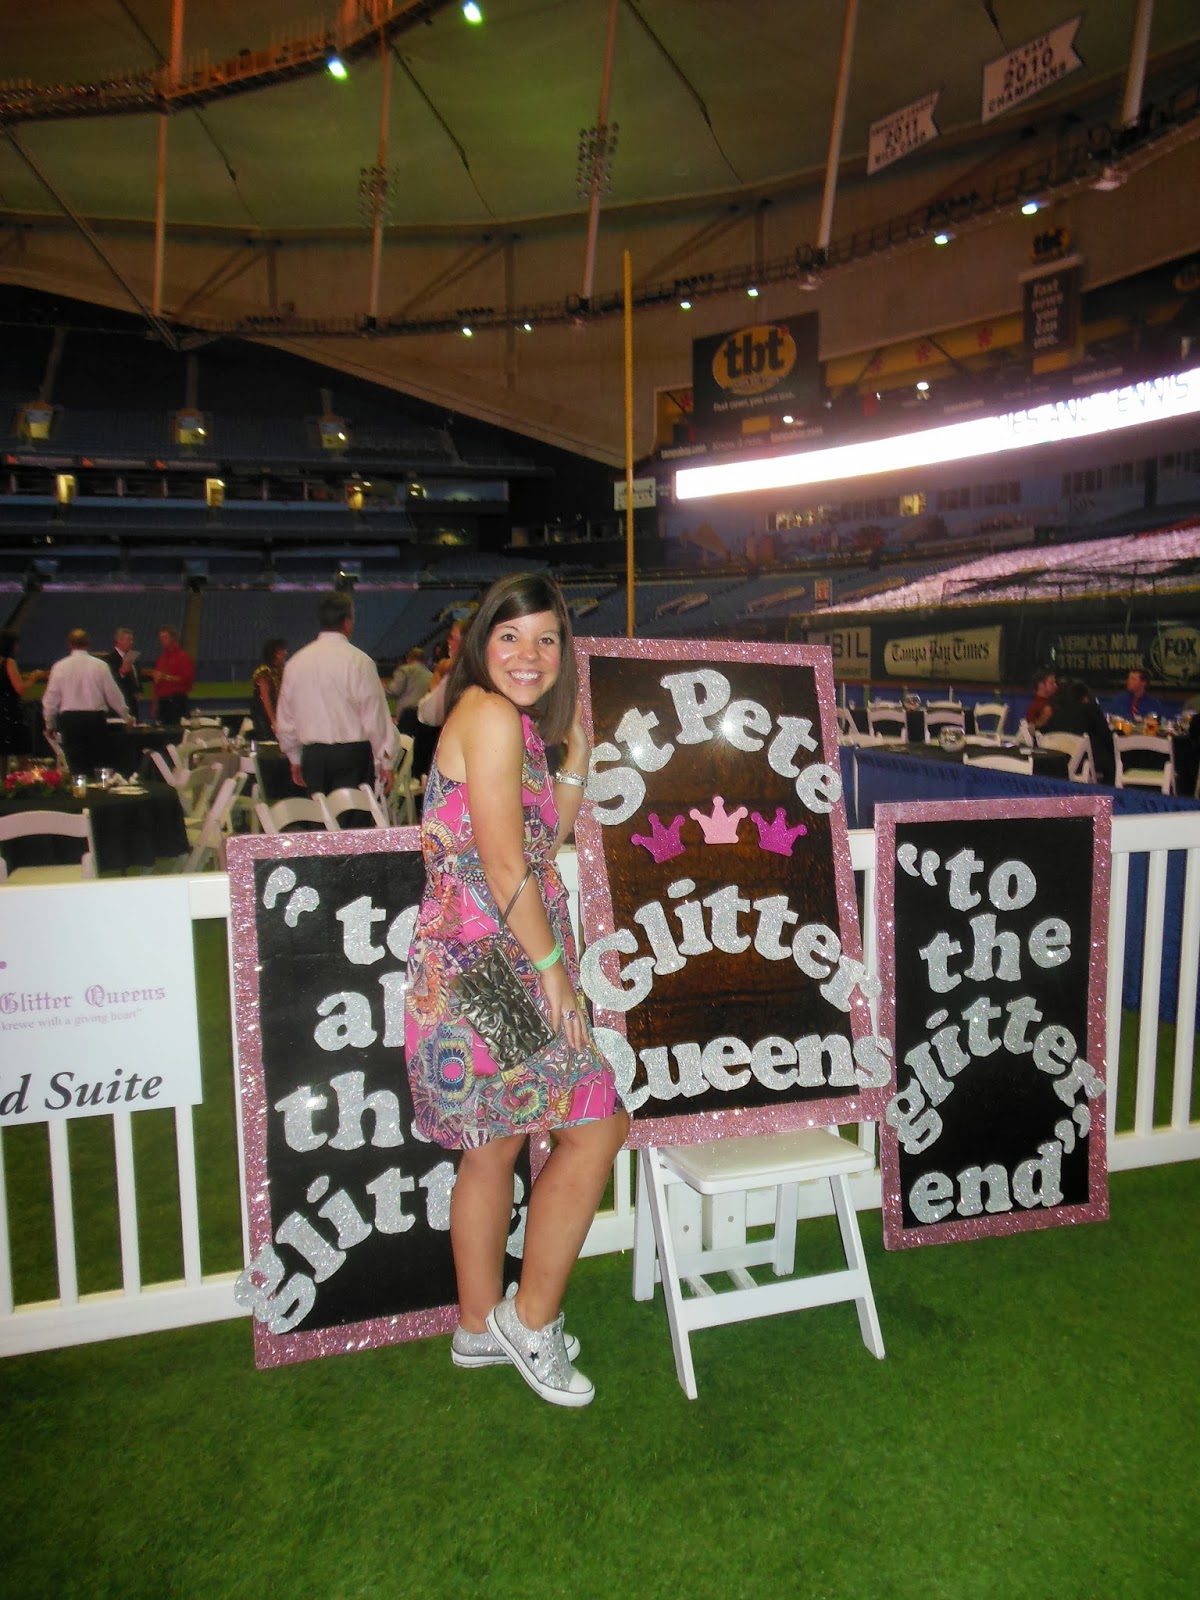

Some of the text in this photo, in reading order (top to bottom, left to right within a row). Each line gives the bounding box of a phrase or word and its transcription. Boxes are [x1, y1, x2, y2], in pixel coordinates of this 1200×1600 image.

[1003, 47, 1054, 92] 2010
[723, 329, 786, 379] tbt
[891, 636, 990, 667] Tampa Bay Times
[1165, 637, 1197, 658] FOX
[582, 668, 842, 826] St Pete
[579, 878, 882, 1012] Glitter
[919, 913, 1071, 993] the
[0, 984, 166, 1014] Glitter Queens
[1, 1020, 34, 1031] krewe
[38, 1016, 62, 1027] with
[64, 1018, 71, 1026] a
[74, 1012, 108, 1027] giving
[45, 1067, 163, 1110] Suite
[886, 996, 1107, 1155] glitter
[274, 1071, 432, 1152] th
[234, 1161, 527, 1334] glitt
